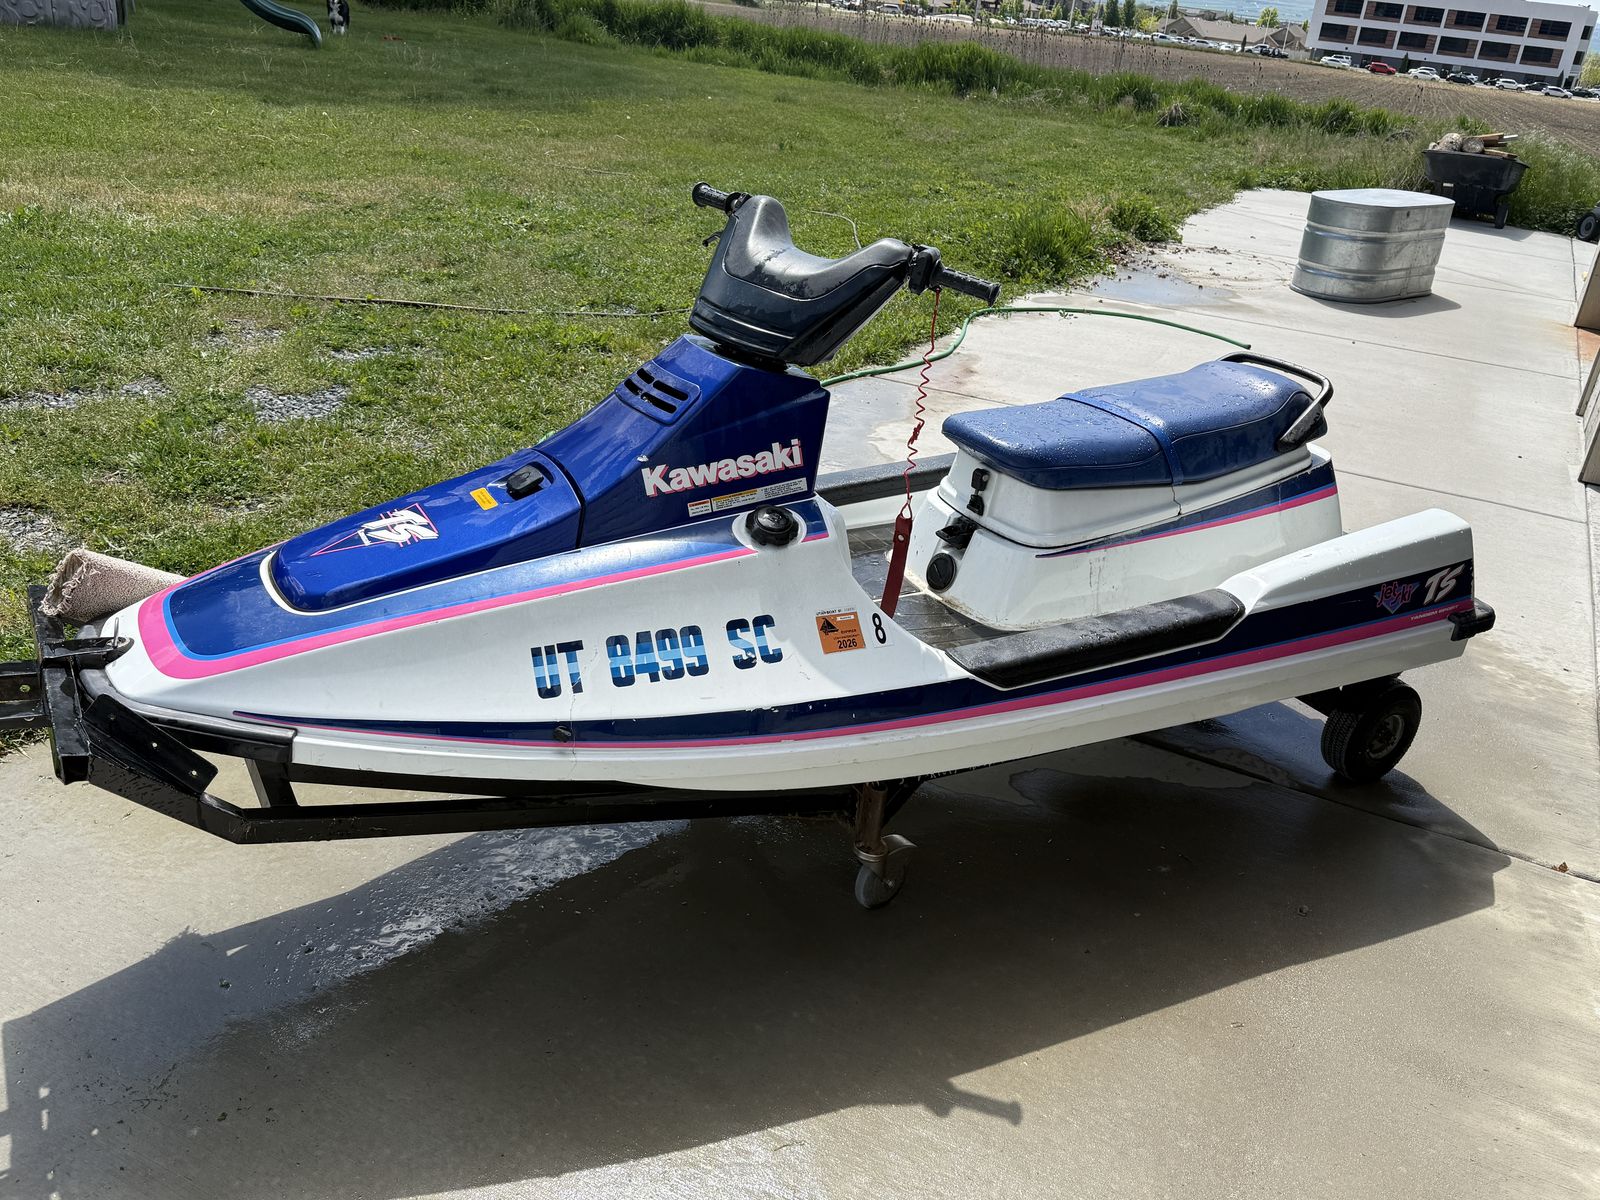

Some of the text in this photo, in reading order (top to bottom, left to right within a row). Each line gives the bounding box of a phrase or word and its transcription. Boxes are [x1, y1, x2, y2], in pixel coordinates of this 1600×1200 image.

[641, 438, 804, 497] Kawasaki
[1424, 563, 1465, 606] TS
[837, 638, 858, 649] 2026
[871, 612, 887, 645] 8
[530, 614, 784, 700] UT 8499 SC
